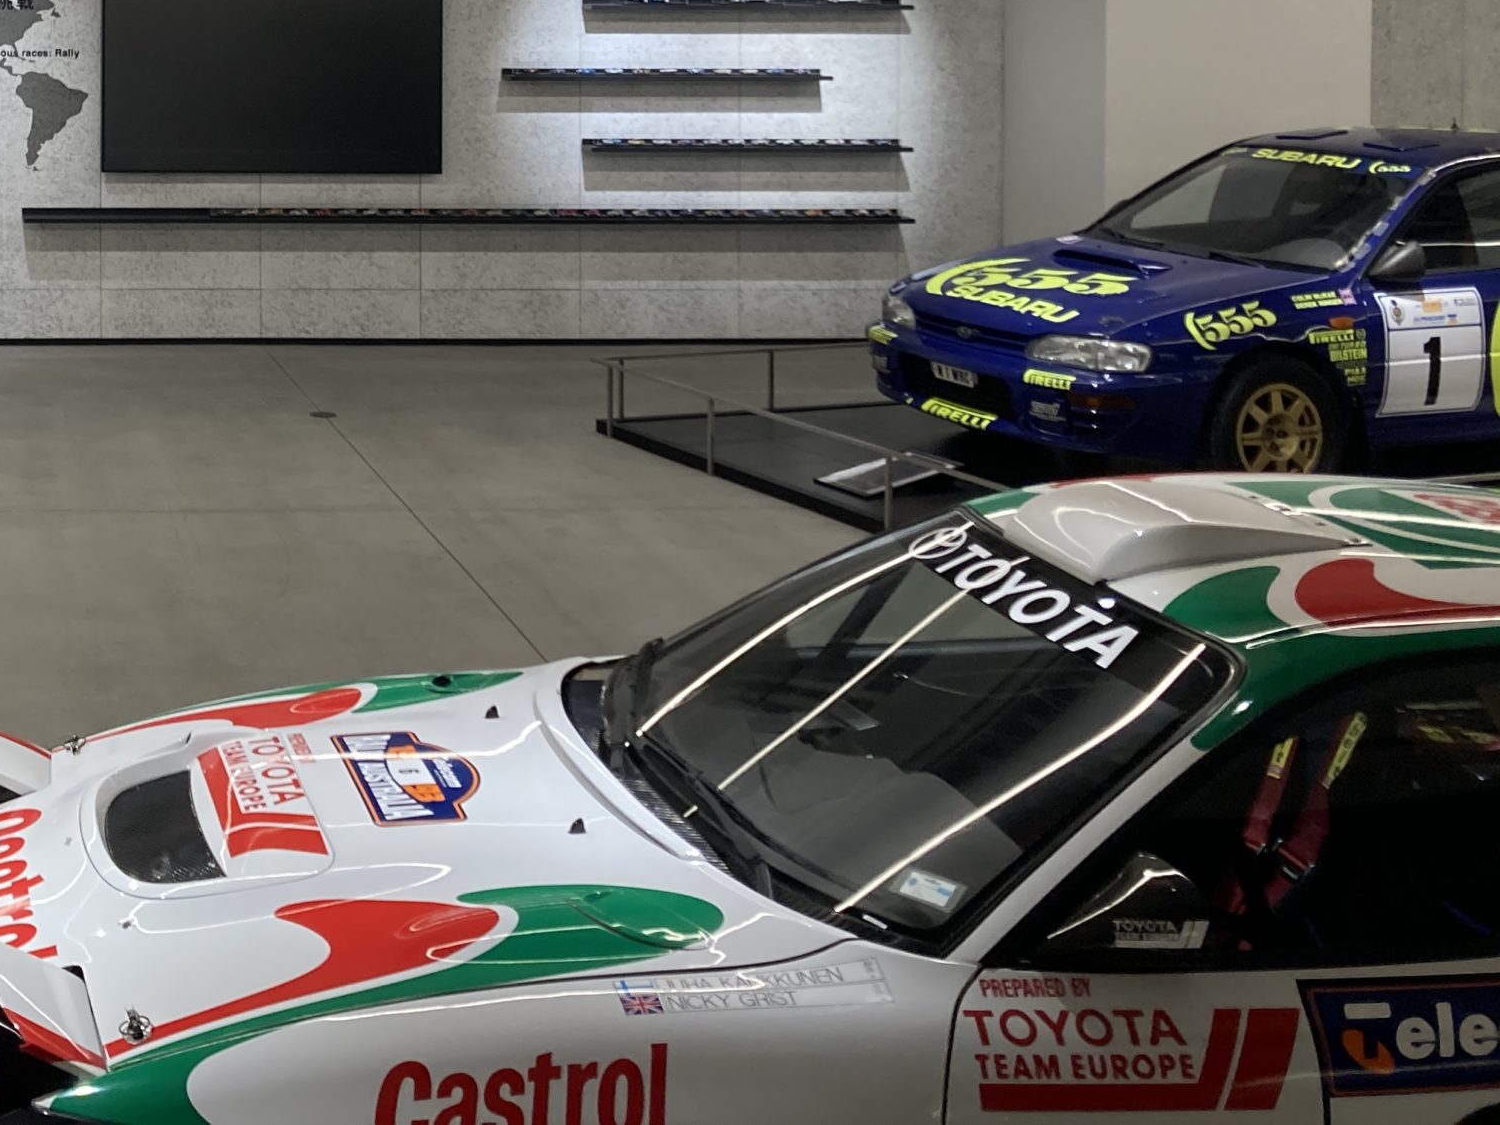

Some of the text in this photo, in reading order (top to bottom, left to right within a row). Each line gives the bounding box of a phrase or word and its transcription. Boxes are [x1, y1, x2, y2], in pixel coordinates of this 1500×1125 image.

[55, 49, 80, 61] Rally
[1251, 147, 1362, 169] SUBARU
[945, 284, 1081, 323] SUBARU
[1023, 368, 1077, 391] PIRELLI
[1423, 336, 1442, 406] 1
[920, 397, 999, 431] PIRELLI
[934, 542, 1140, 670] TOYOTA
[1112, 919, 1179, 933] TOYOTA
[666, 990, 797, 1010] NICKY GRIST
[979, 977, 1092, 998] PREPARED BY
[963, 1008, 1188, 1047] TOYOTA
[974, 1053, 1197, 1080] TEAM EUROPE
[375, 1042, 669, 1125] Castrol
